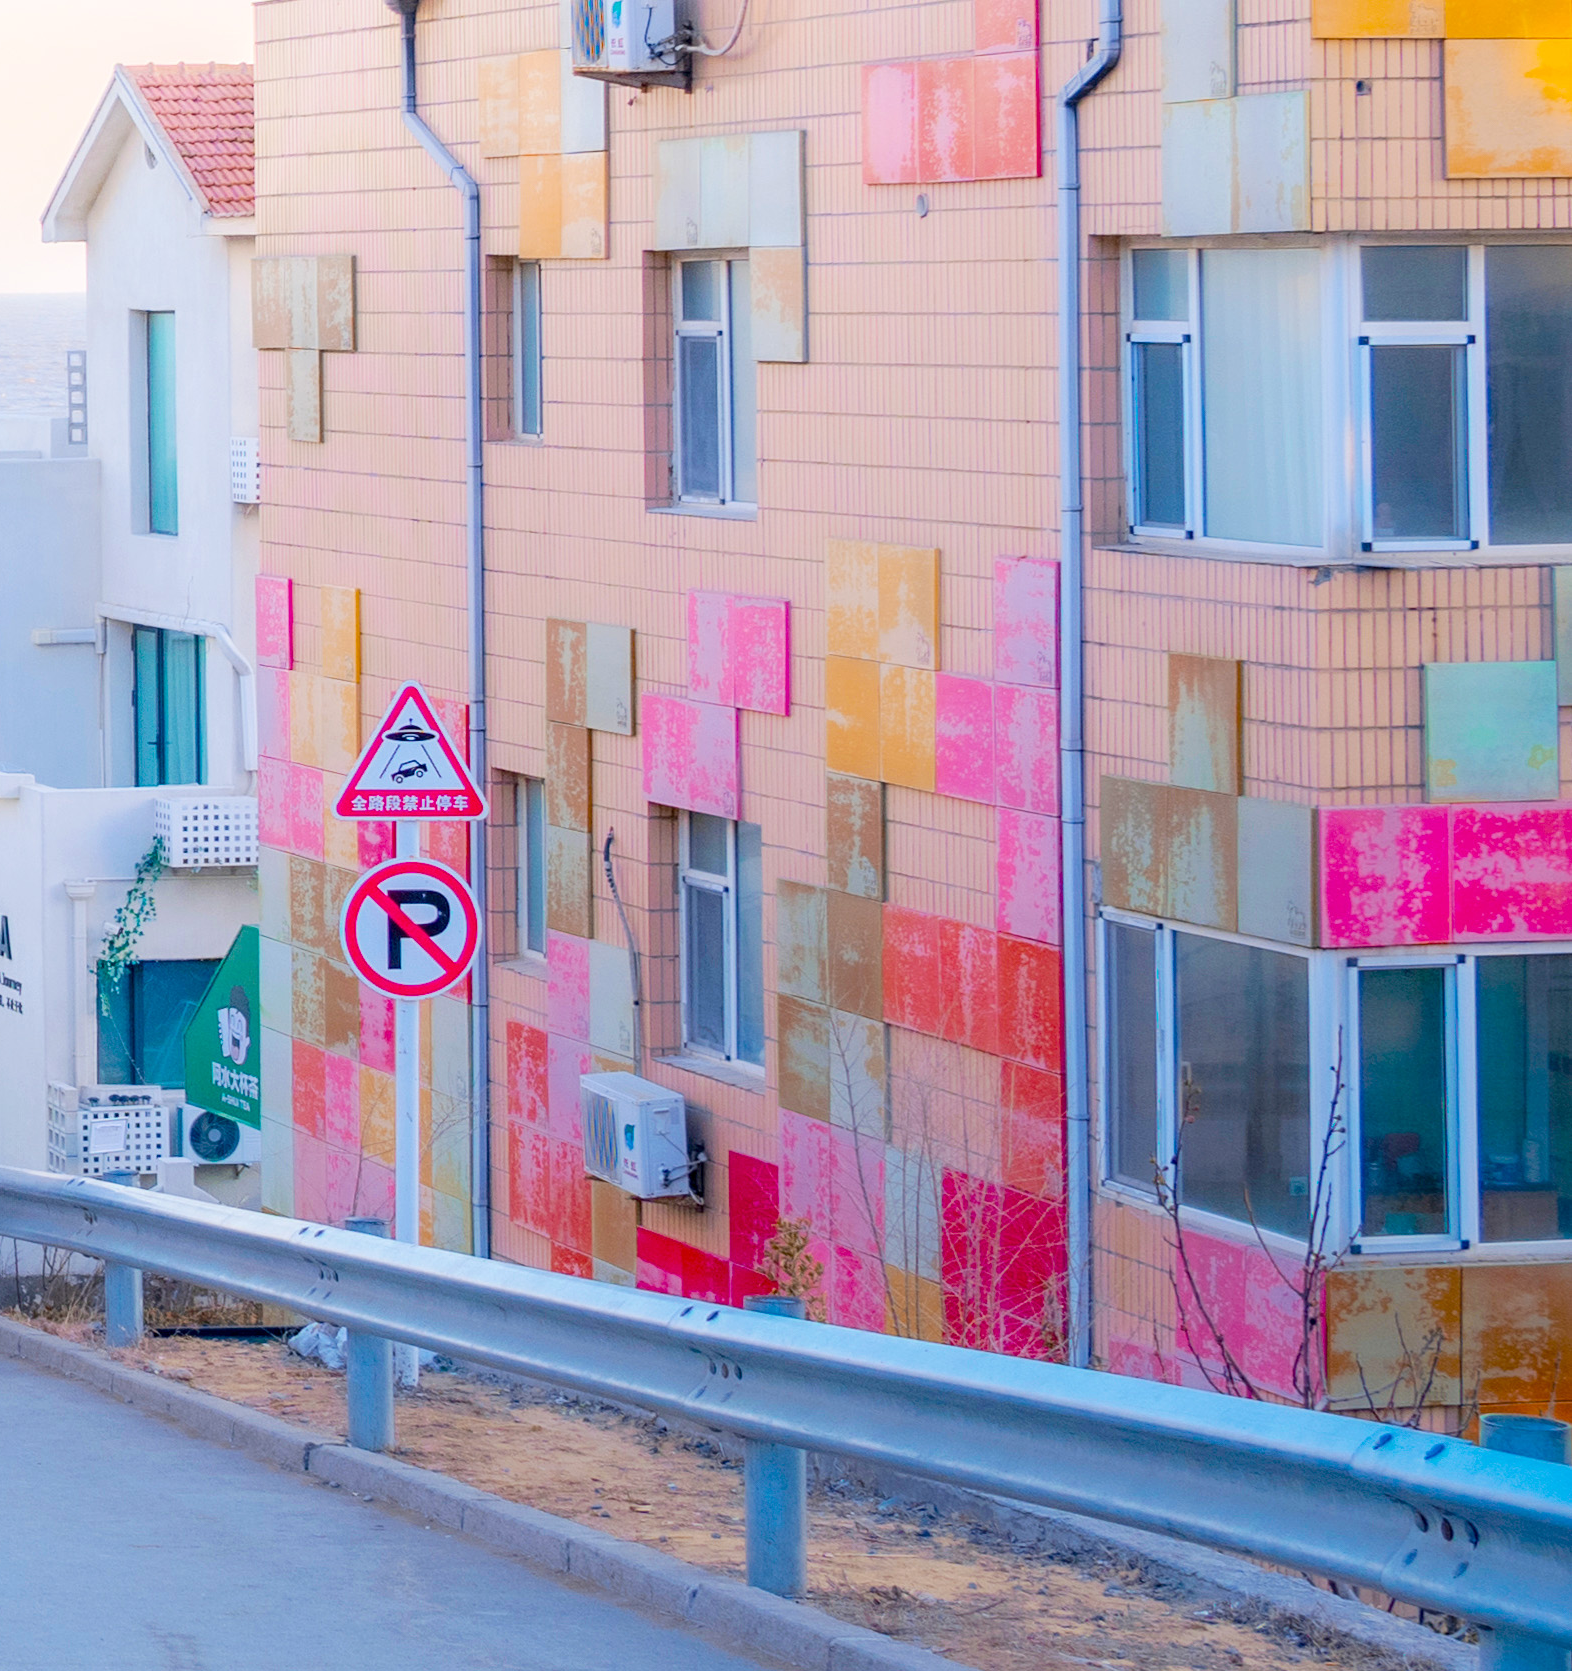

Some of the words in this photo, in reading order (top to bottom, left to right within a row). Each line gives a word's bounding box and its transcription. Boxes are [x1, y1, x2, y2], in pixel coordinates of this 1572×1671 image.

[351, 794, 469, 812] 全路段禁止停车
[388, 889, 451, 970] P
[211, 1061, 259, 1101] 阿水大杯茶
